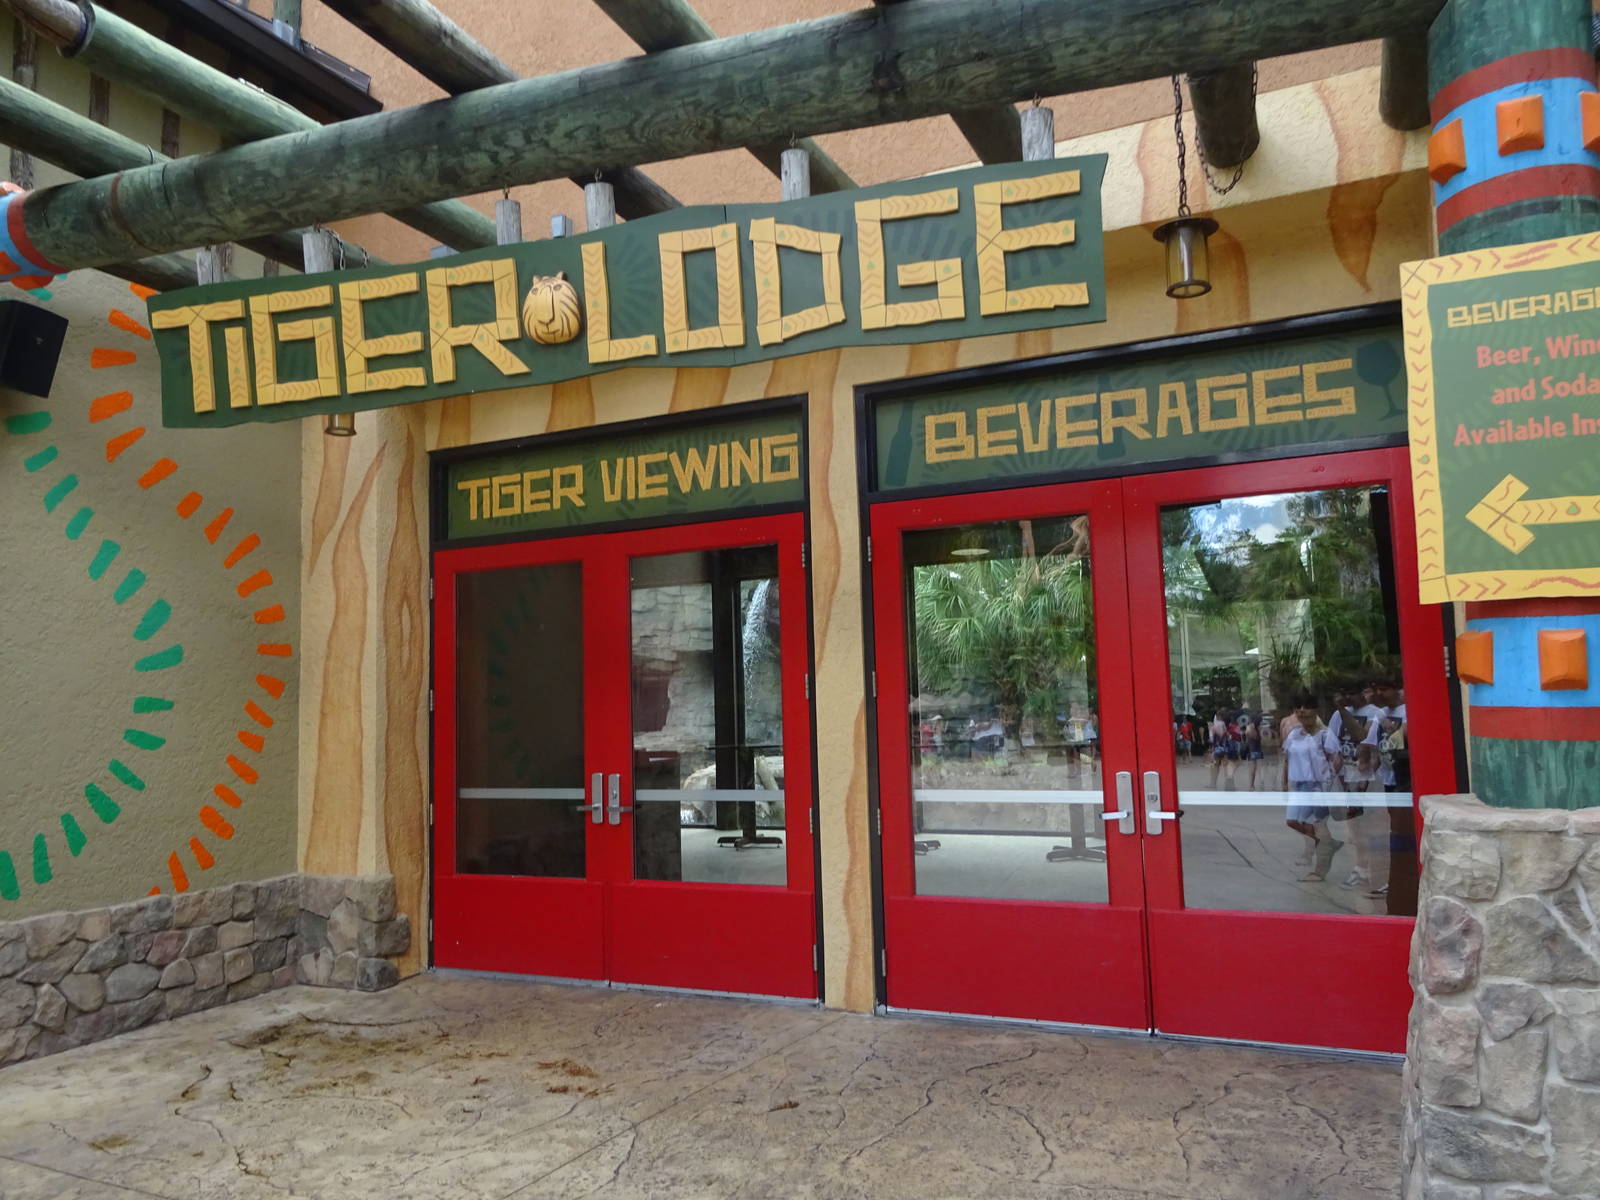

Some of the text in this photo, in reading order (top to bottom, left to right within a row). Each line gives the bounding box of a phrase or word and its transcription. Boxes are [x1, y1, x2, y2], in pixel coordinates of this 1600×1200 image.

[151, 169, 1089, 413] TIGER LODGE
[1476, 345, 1541, 369] Beer,
[924, 358, 1357, 465] BEVERAGES
[1491, 378, 1536, 405] and
[1454, 416, 1568, 447] Available
[457, 433, 799, 521] TIGER VIEWING
